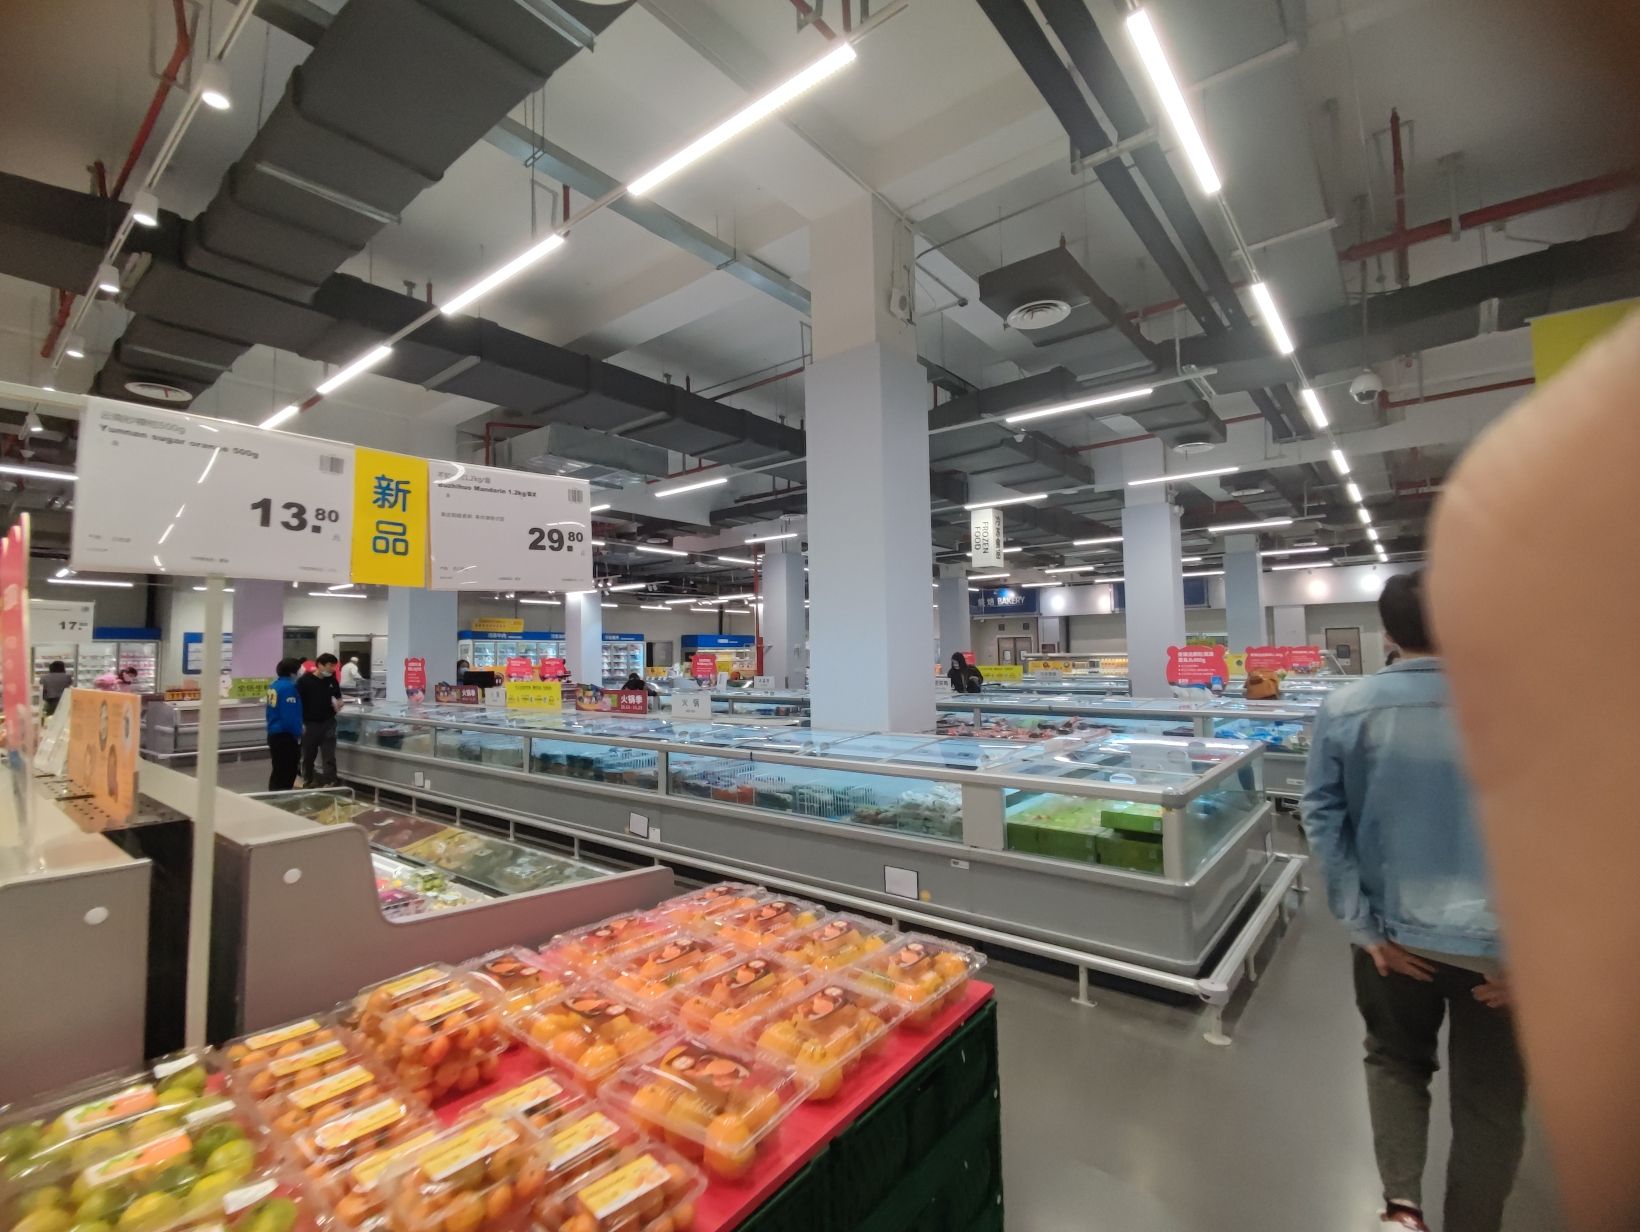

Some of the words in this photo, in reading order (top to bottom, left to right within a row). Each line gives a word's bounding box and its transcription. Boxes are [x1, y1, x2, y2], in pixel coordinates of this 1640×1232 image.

[152, 434, 186, 445] sugar
[189, 441, 229, 452] orane
[232, 447, 259, 460] 500g
[474, 485, 507, 495] Mandarin
[372, 474, 411, 556] 新品
[997, 595, 1026, 605] BAKERY
